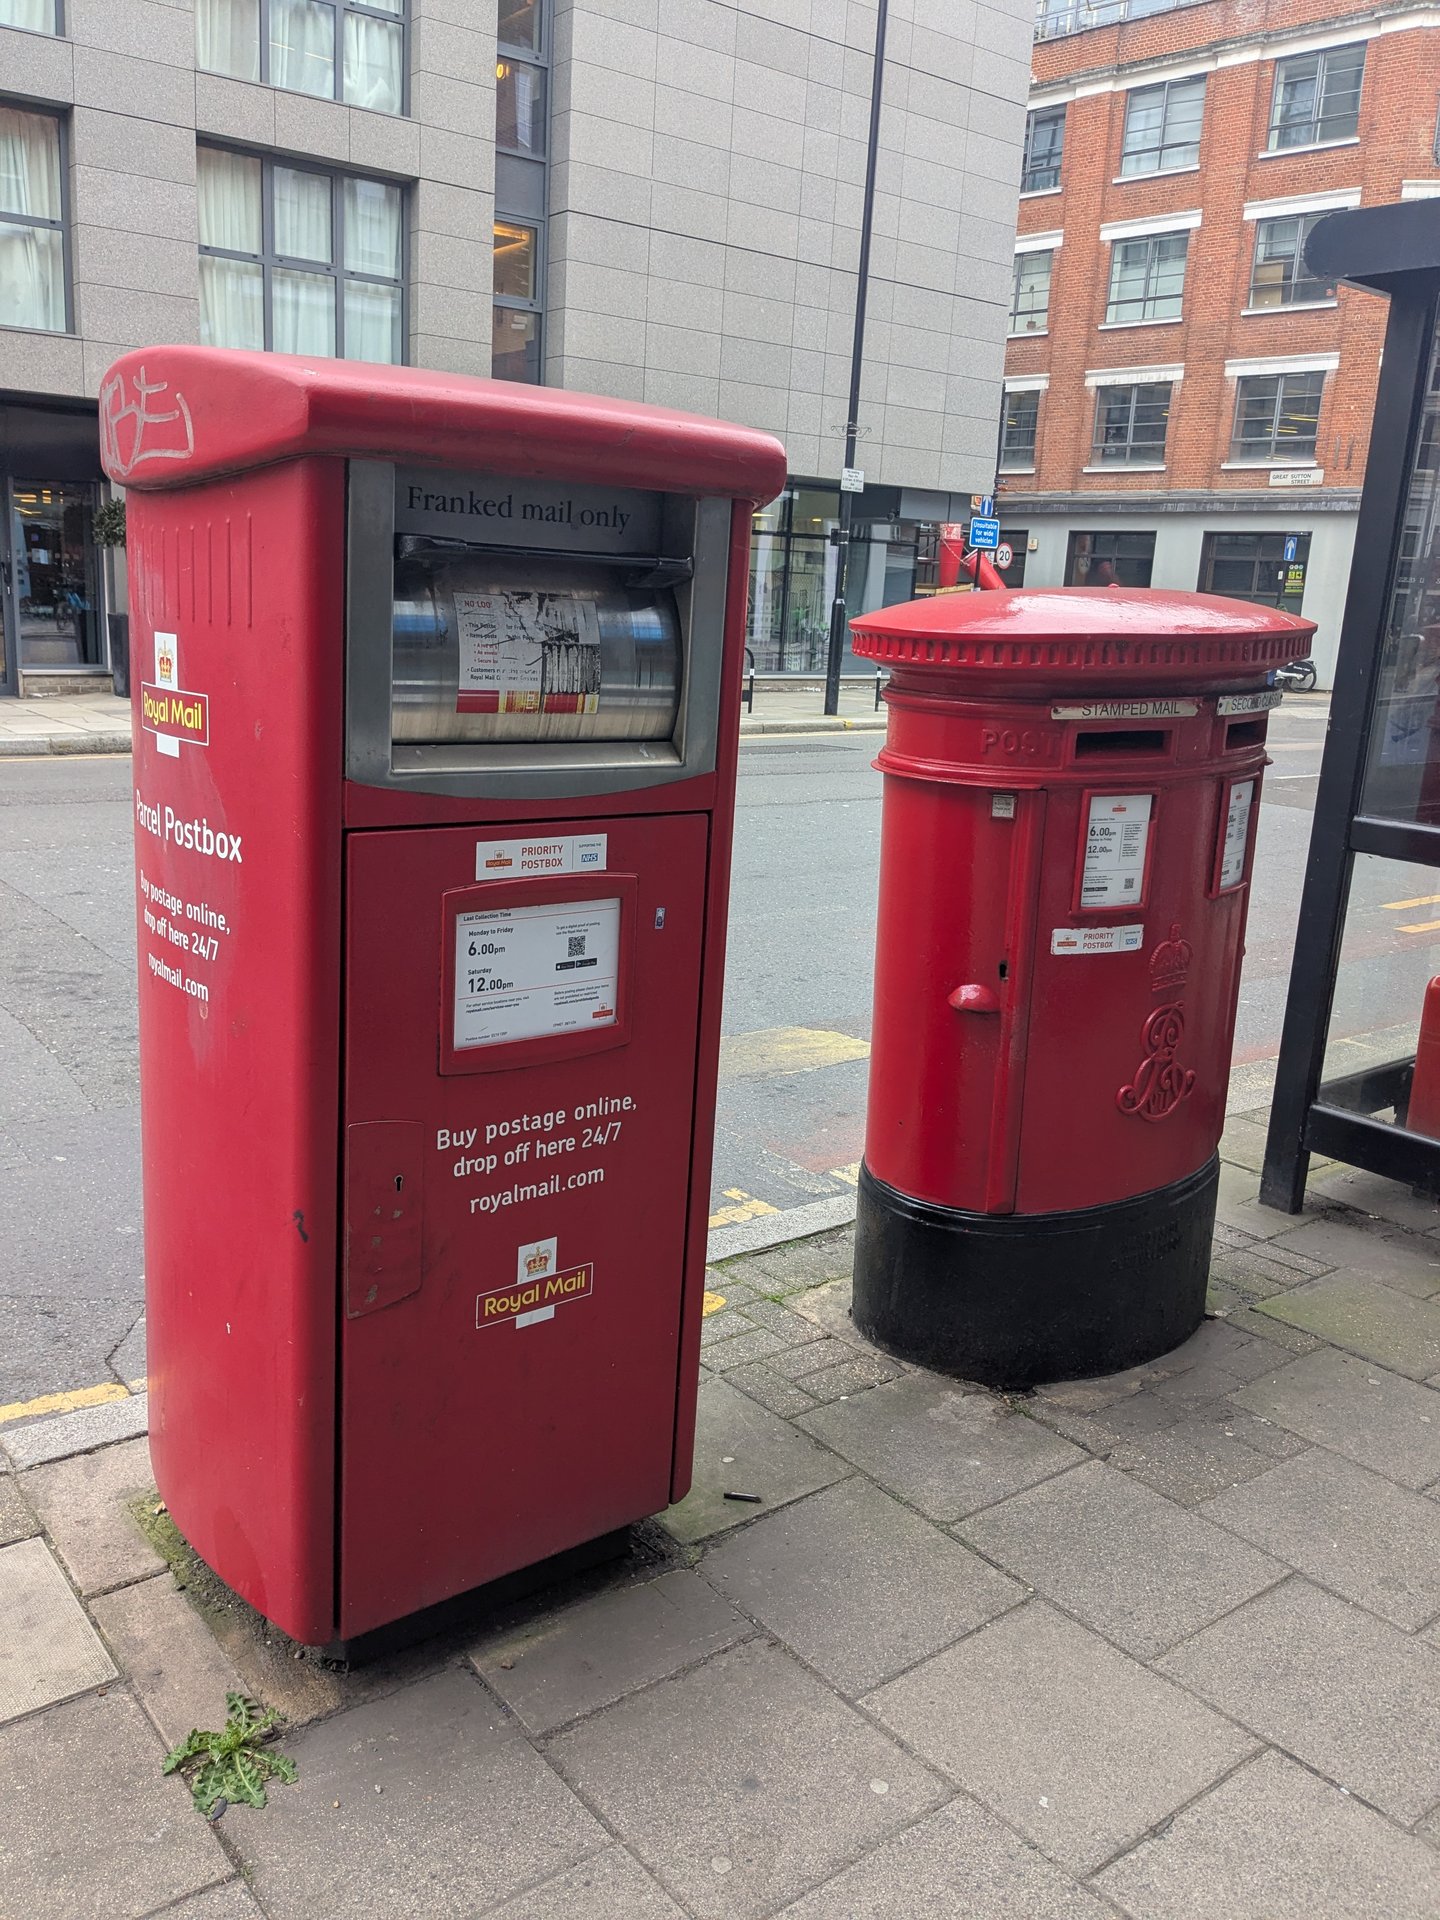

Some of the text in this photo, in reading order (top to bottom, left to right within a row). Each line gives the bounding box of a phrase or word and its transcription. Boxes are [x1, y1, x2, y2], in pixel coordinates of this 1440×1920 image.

[407, 485, 631, 534] Franked mail only
[973, 521, 998, 529] Unsuitable
[983, 529, 994, 537] wide
[999, 550, 1010, 562] 20
[143, 690, 202, 730] Royal Mail
[1081, 701, 1181, 717] STAMPED MAIL
[136, 788, 243, 863] Parcel Postbox
[1089, 825, 1117, 837] 6.00pm
[521, 844, 564, 857] PRIORITY
[1087, 845, 1113, 854] 12.00pm
[521, 857, 563, 870] POSTBOX
[582, 853, 598, 862] NHS
[140, 868, 231, 935] Buy postage online,
[474, 912, 499, 920] Collection
[144, 904, 219, 961] drop off here 24/7
[468, 929, 490, 937] Monday
[496, 926, 514, 934] Friday
[1083, 932, 1115, 940] PRIORITY
[468, 941, 506, 956] 6.00pm
[1082, 941, 1114, 949] POSTBOX
[148, 951, 209, 1002] royalmail.com
[467, 967, 492, 976] Saturday
[468, 976, 514, 993] 12.00pm
[436, 1095, 637, 1150] Buy postage online,
[453, 1121, 622, 1177] drop off here 24/7
[469, 1166, 605, 1215] royalmail.com
[484, 1270, 586, 1318] Royal Mail
